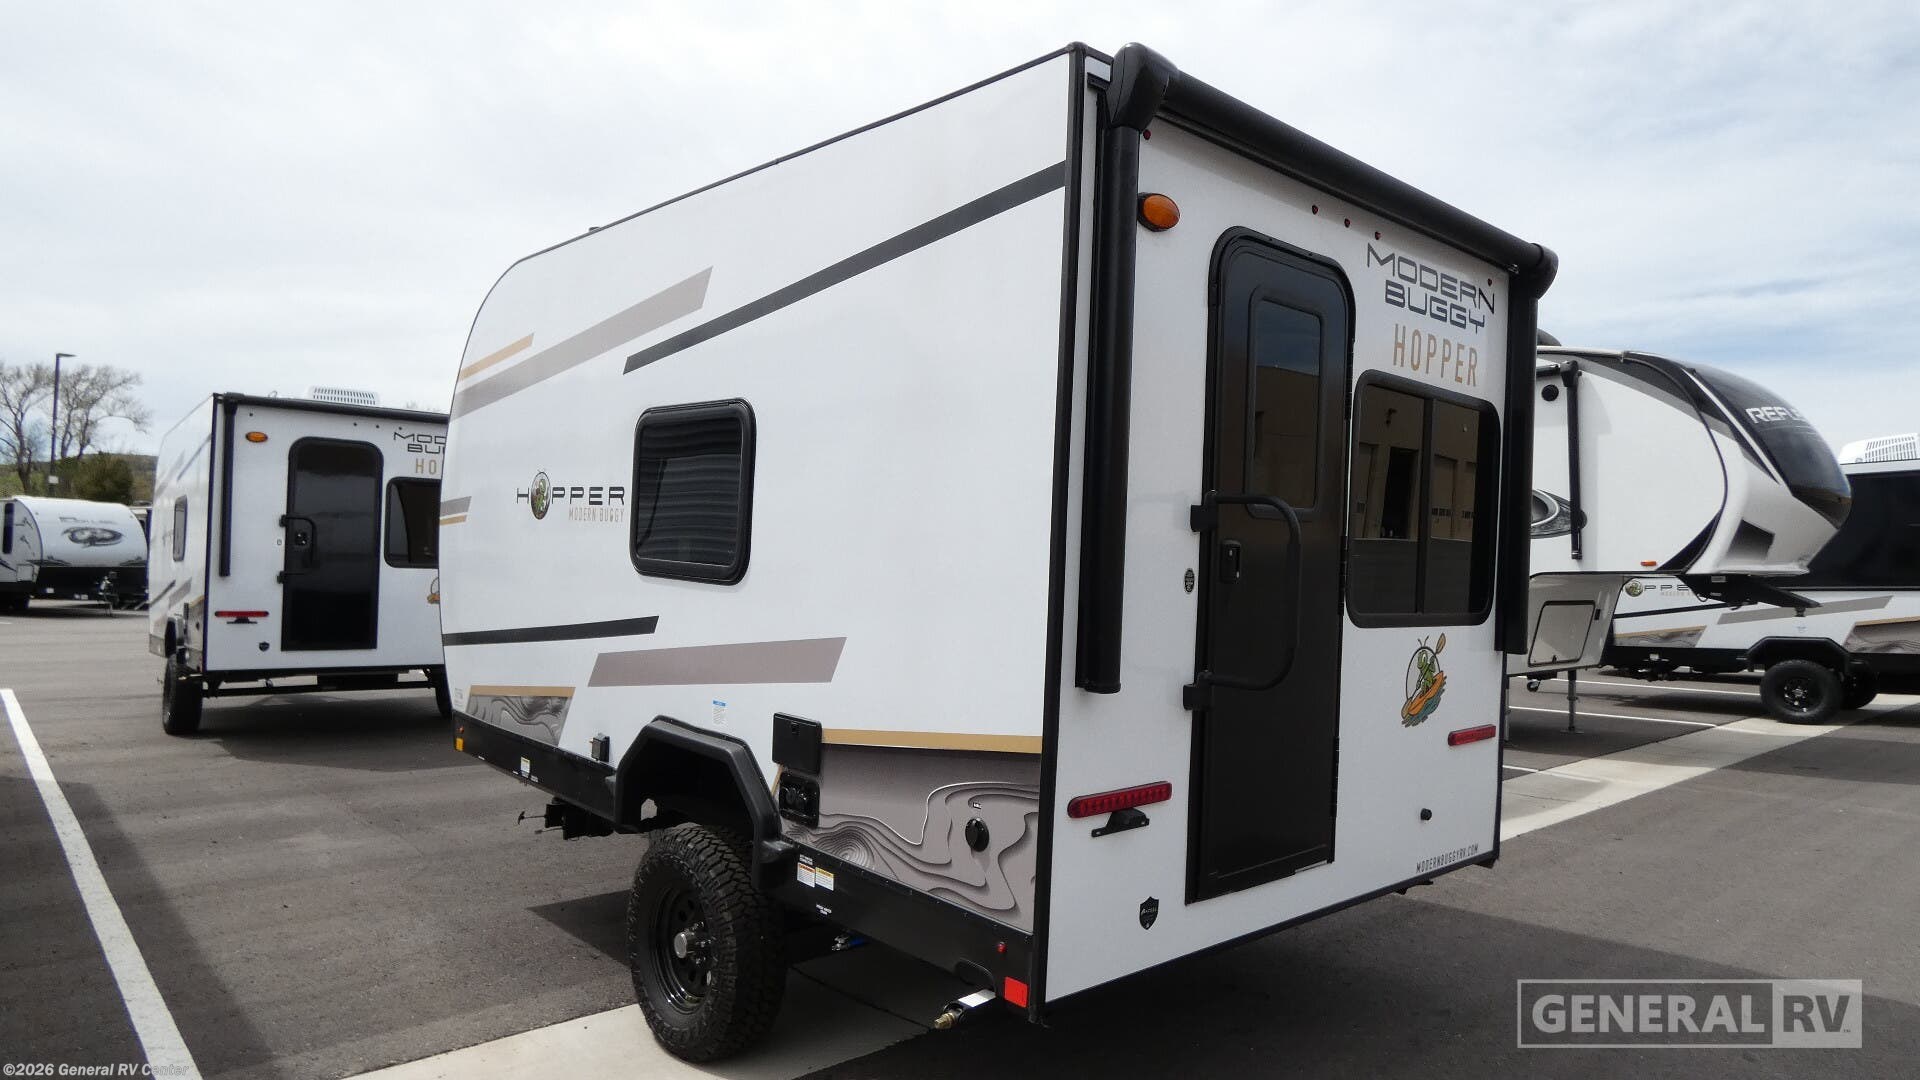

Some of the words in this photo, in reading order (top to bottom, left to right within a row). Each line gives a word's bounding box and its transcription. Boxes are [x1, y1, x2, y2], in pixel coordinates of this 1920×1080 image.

[1367, 242, 1495, 315] MODERN
[1385, 279, 1486, 334] BUGGY
[1393, 323, 1478, 387] HOPPER
[407, 443, 446, 455] BU
[516, 471, 625, 520] HOPPER
[568, 507, 597, 521] MODERN
[600, 508, 625, 523] BUGGY
